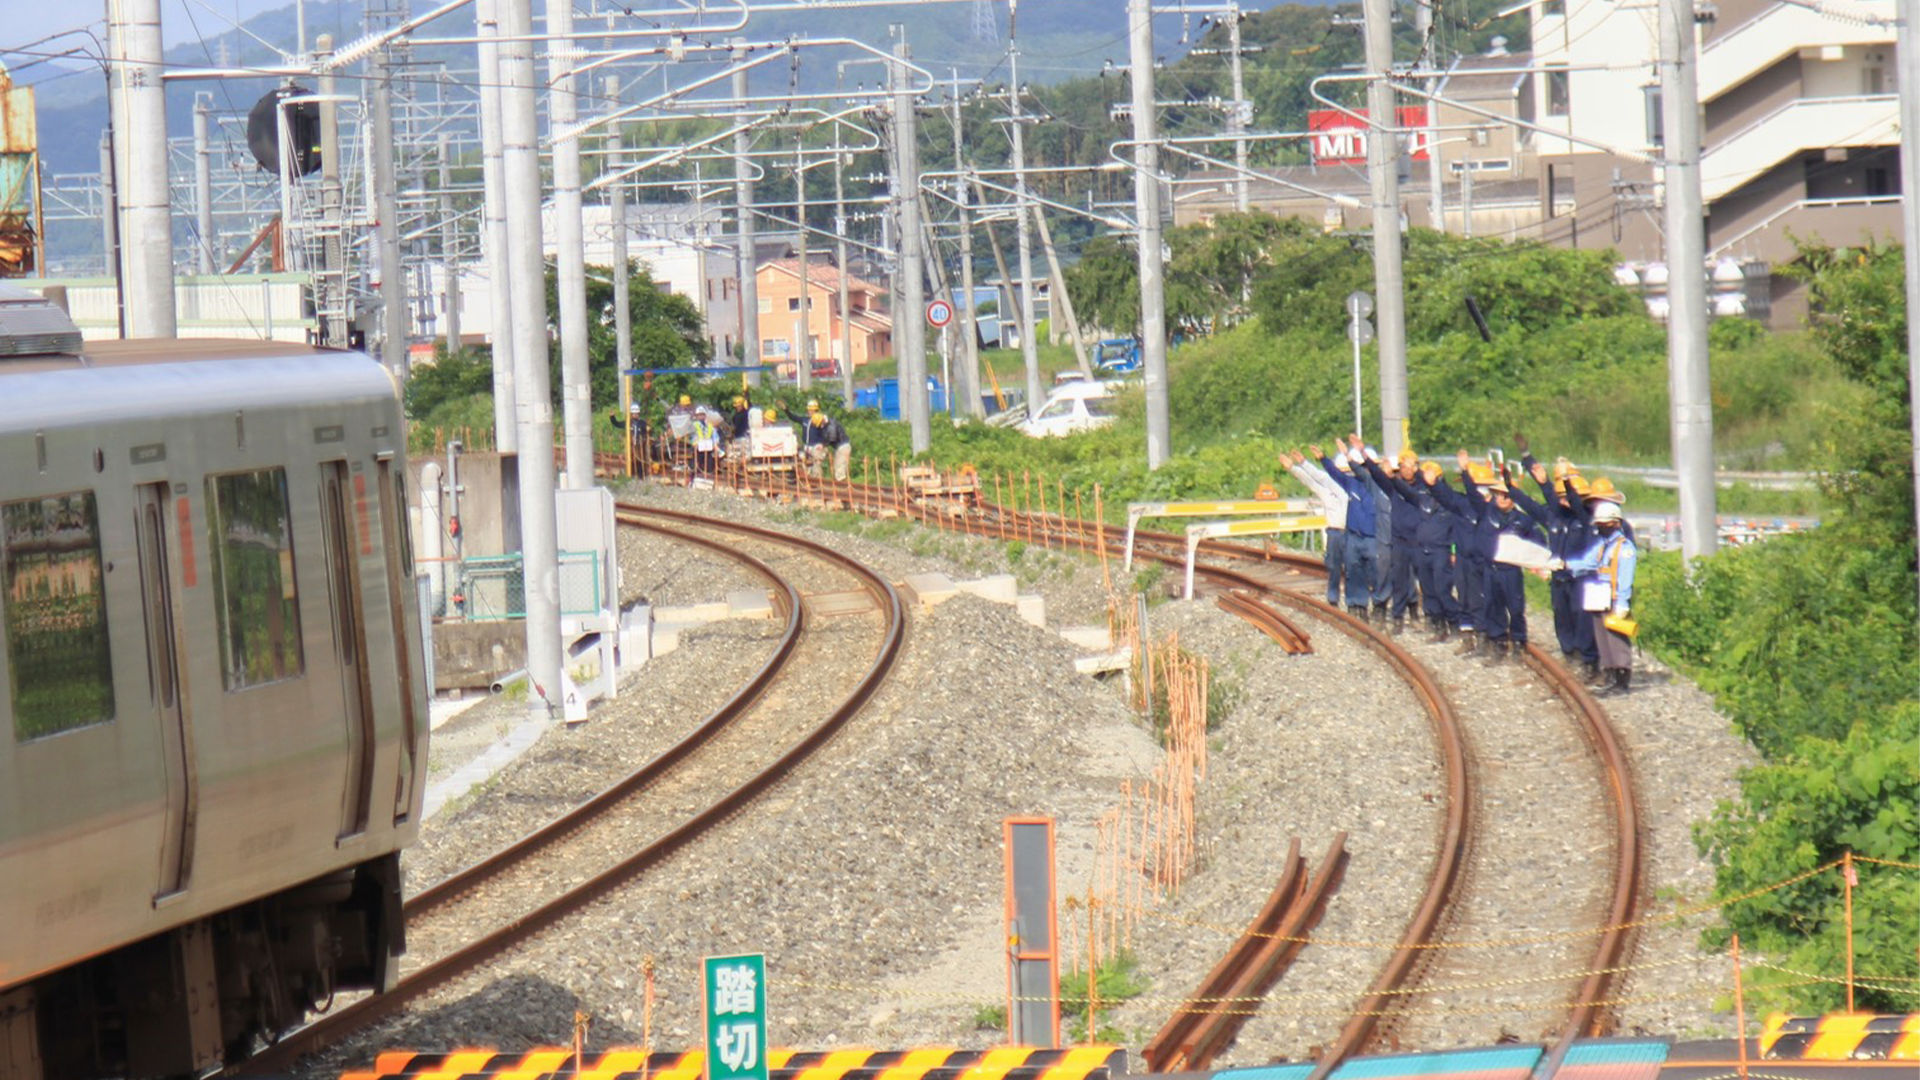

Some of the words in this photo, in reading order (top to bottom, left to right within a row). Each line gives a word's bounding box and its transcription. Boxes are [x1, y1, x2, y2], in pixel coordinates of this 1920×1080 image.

[932, 308, 947, 320] 40
[566, 692, 576, 706] 4
[714, 965, 758, 1072] 踏切
